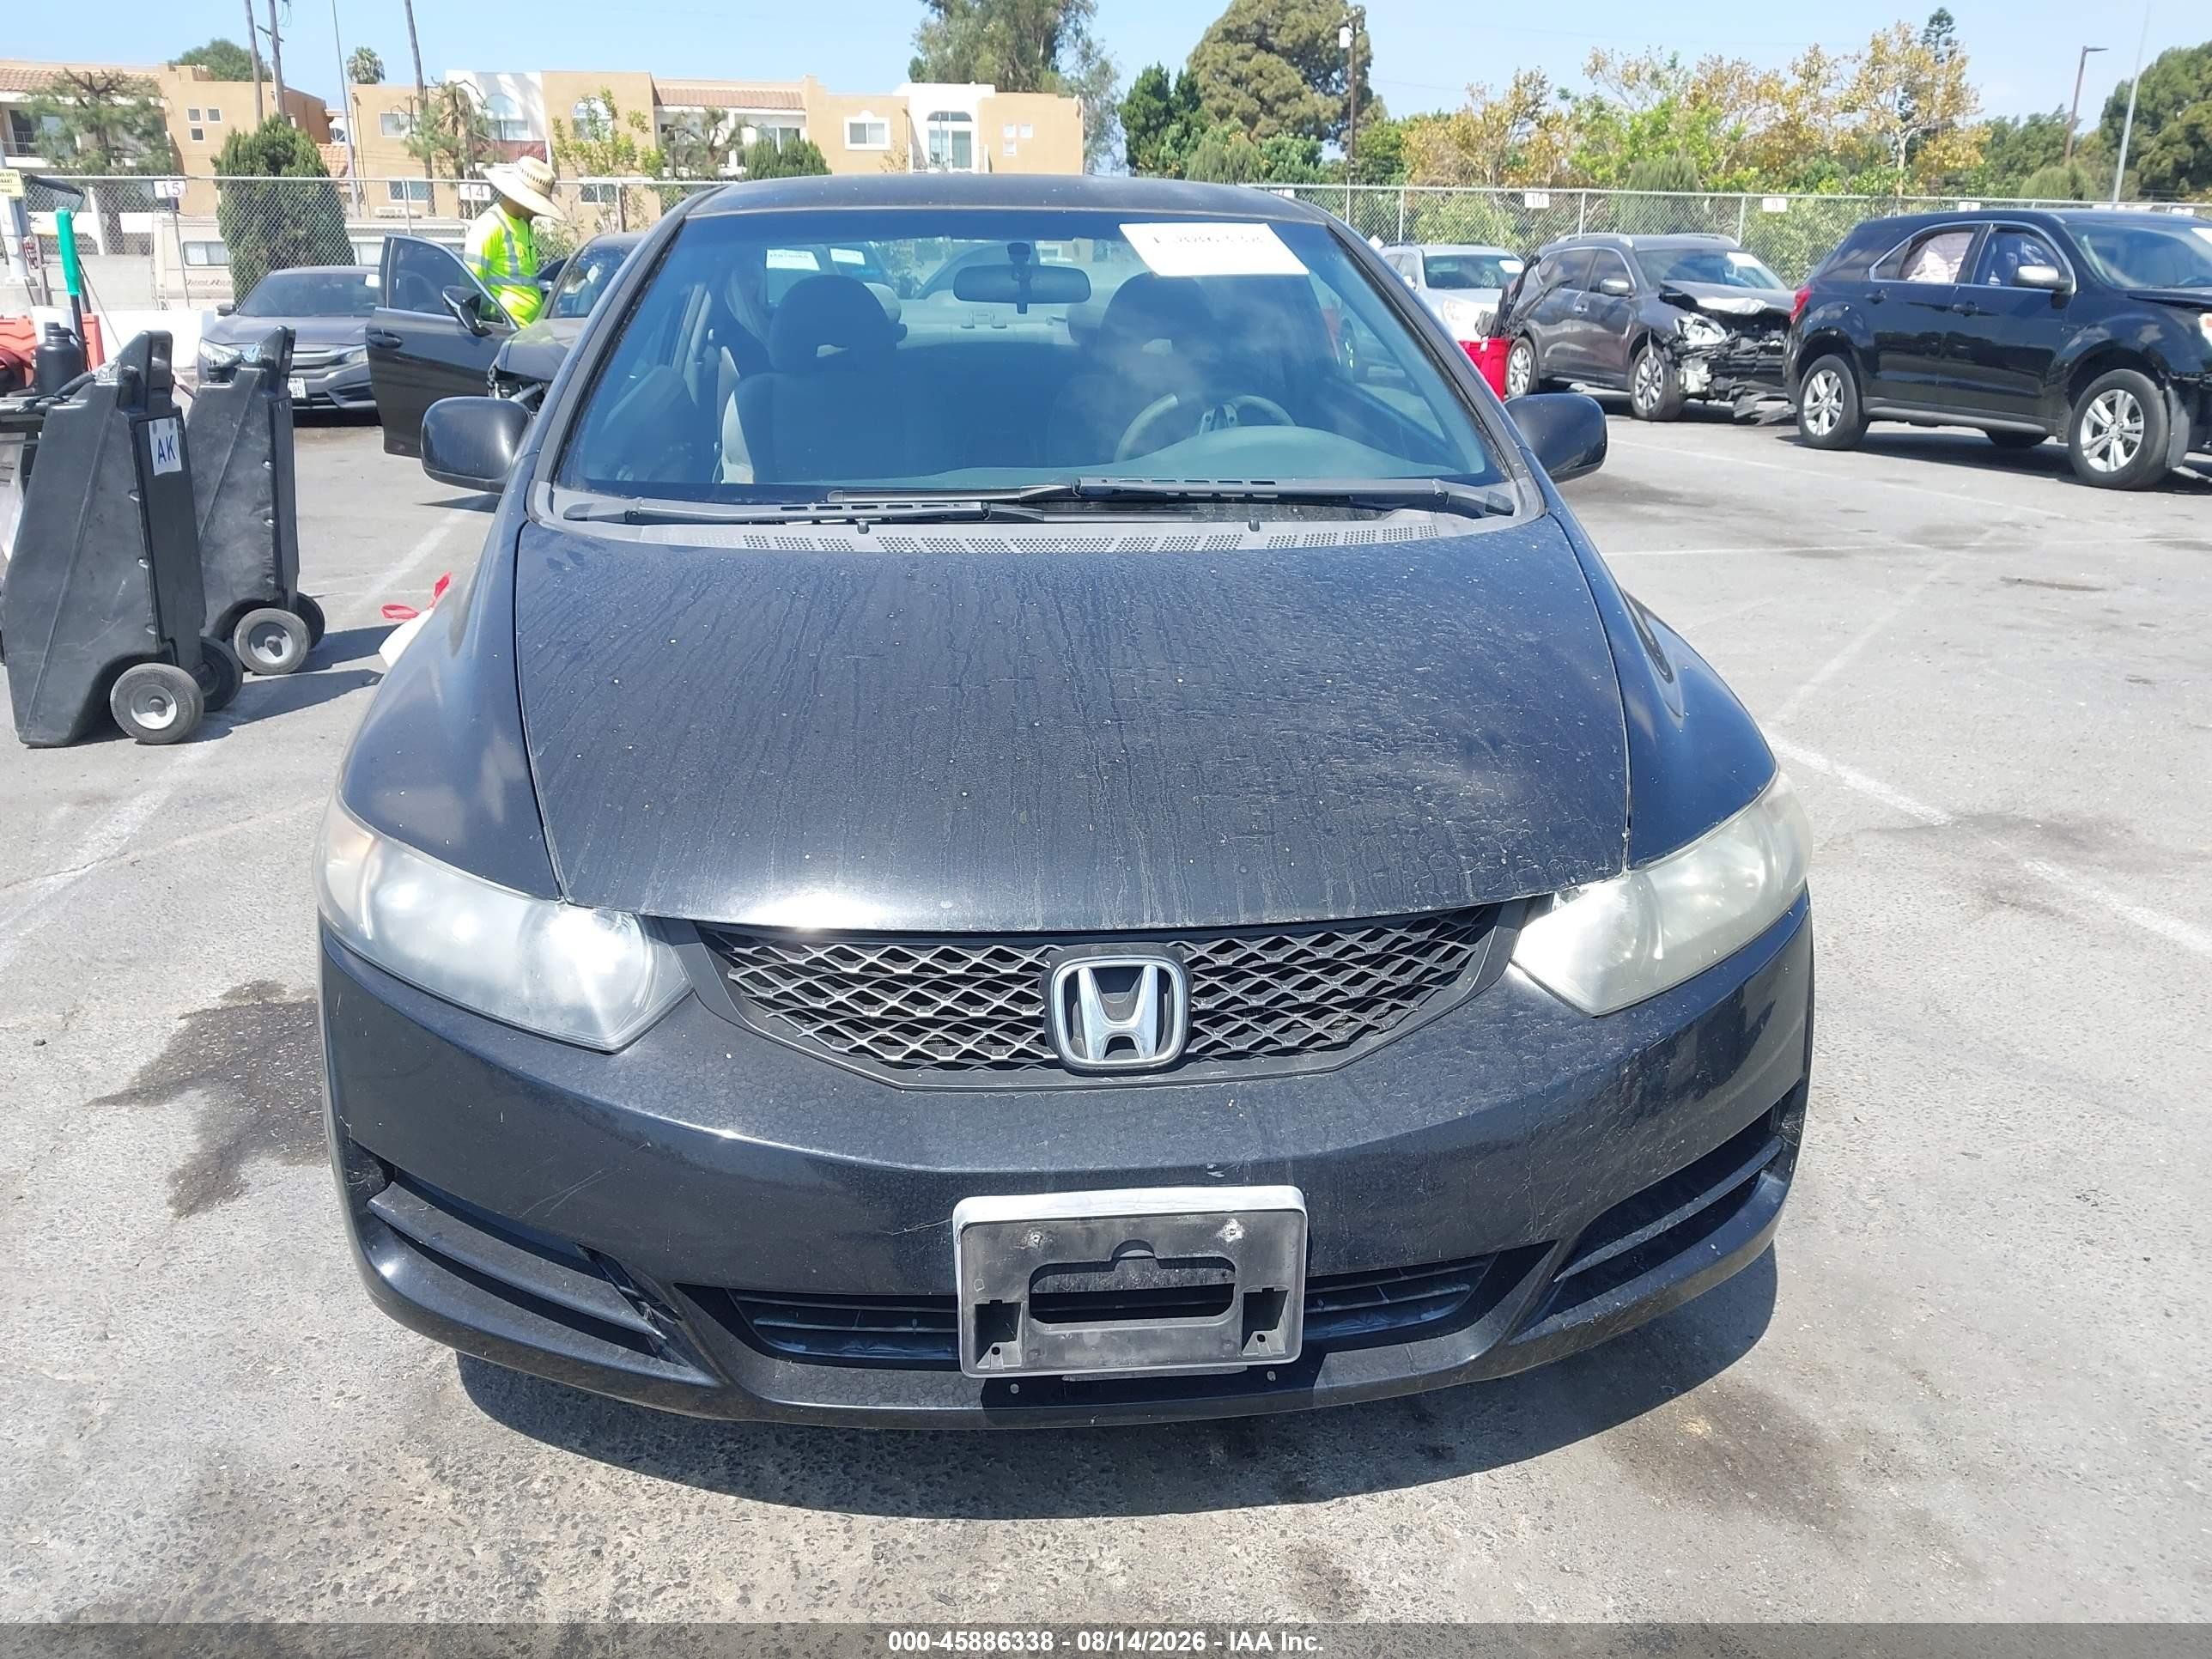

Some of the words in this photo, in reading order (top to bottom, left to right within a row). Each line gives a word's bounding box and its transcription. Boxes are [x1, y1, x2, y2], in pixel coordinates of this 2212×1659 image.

[161, 182, 181, 196] 15
[465, 184, 485, 198] 14
[1531, 192, 1545, 206] 10
[157, 434, 176, 465] AK
